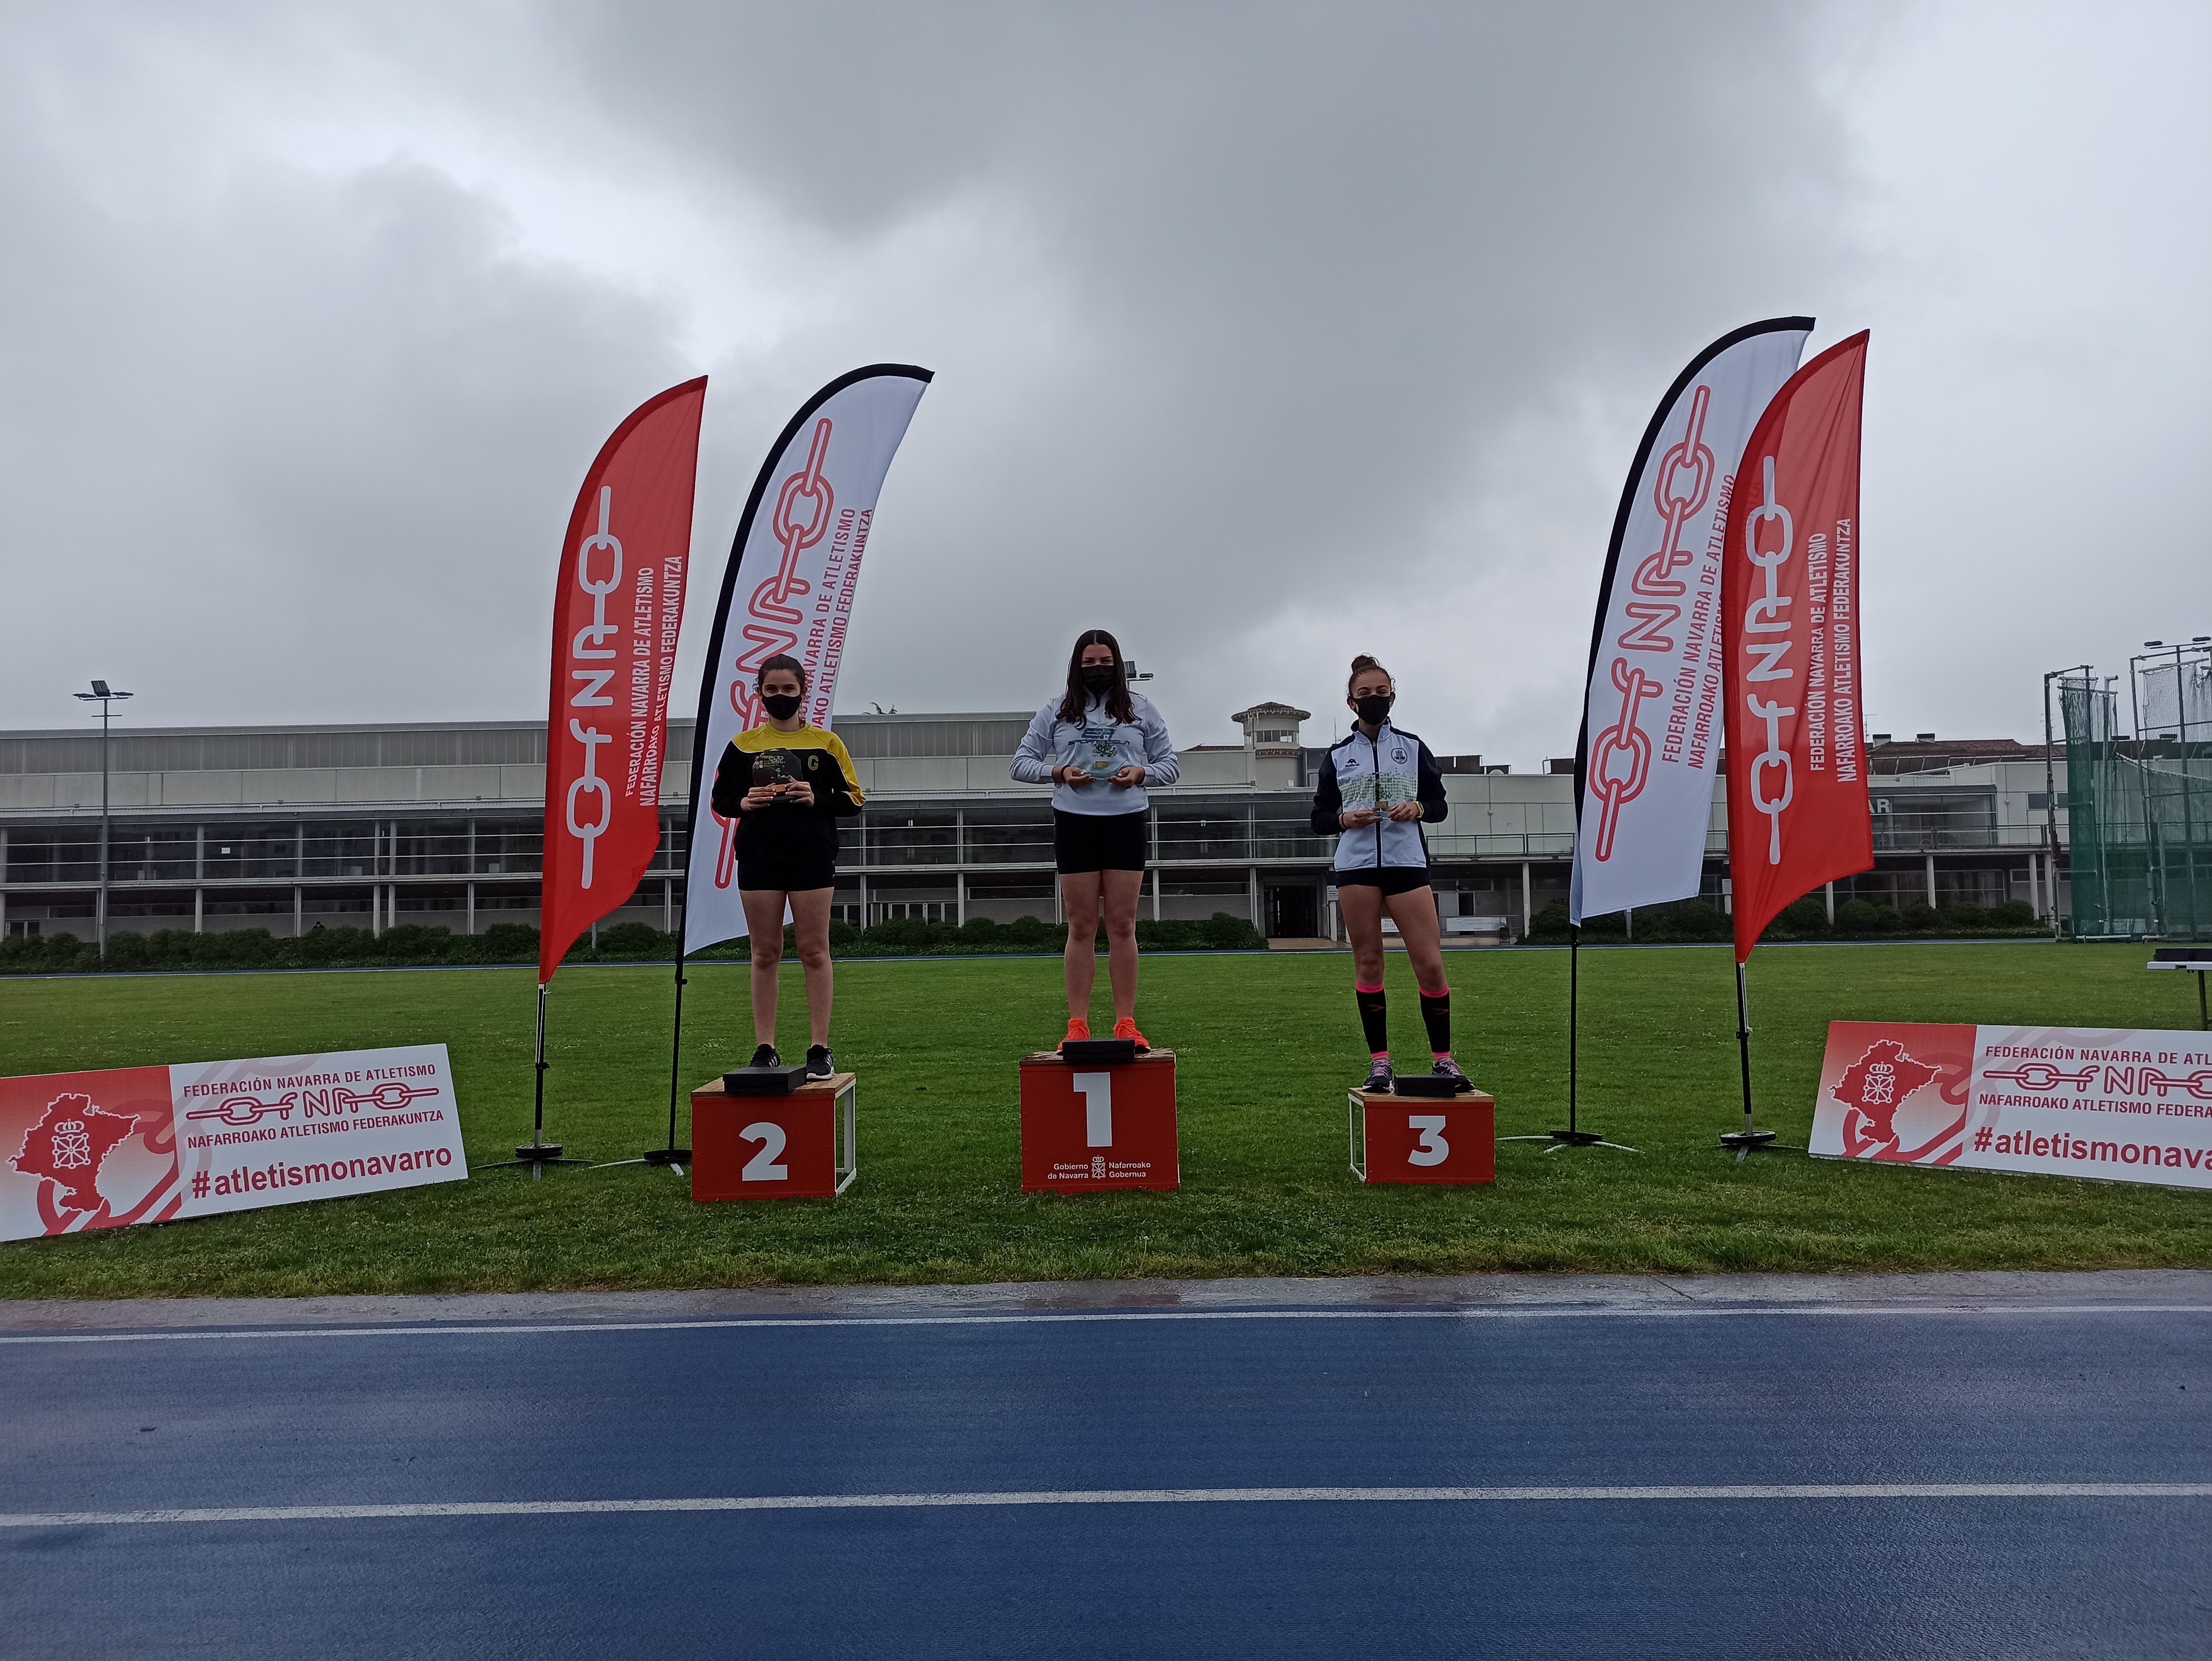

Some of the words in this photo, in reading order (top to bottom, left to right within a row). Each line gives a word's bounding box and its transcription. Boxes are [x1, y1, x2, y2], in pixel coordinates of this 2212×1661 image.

[822, 509, 855, 589] ATLETISMO
[1706, 474, 1735, 562] ATLETISMO
[634, 567, 654, 636] ATLETISMO
[819, 617, 847, 694] ATLETISMO
[836, 509, 873, 613] FEDERAKUNTZA
[1700, 565, 1717, 586] DE
[1808, 533, 1827, 603] ATLETISMO
[1833, 519, 1850, 620] FEDERAKUNTZA
[661, 556, 682, 653] FEDERAKUNTZA
[816, 594, 832, 612] DE
[1682, 591, 1712, 663] NAVARRA
[1810, 607, 1825, 623] DE
[633, 640, 651, 656] DE
[1688, 674, 1719, 769] NAFARROAKO
[1707, 594, 1722, 673] ATLETIS
[1808, 627, 1825, 687] NAVARRA
[1834, 624, 1851, 694] ATLETISMO
[630, 660, 650, 717] NAVARRA
[653, 656, 673, 721] ATLETISMO
[1662, 666, 1697, 763] FEDERACIÓN
[625, 721, 647, 797] FEDERACIÓN
[808, 755, 818, 770] G
[1804, 691, 1826, 771] FEDERACIÓN
[1834, 698, 1857, 782] NAFARROAKO
[640, 725, 660, 807] NAFARROAKO
[183, 1077, 272, 1098] FEDERACIÓN
[277, 1072, 342, 1089] NAVARRA
[344, 1069, 362, 1083] DE
[365, 1063, 436, 1081] ATLETISMO
[1985, 1045, 2075, 1061] FEDERACIÓN
[2080, 1049, 2152, 1063] NAVARRA
[2158, 1052, 2178, 1063] DE
[2184, 1053, 2212, 1065] ATL
[188, 1128, 277, 1148] NAFARROAKO
[280, 1121, 350, 1139] ATLETISMO
[353, 1110, 444, 1131] FEDERAKUNTZA
[1073, 1072, 1112, 1147] 1
[1408, 1115, 1449, 1166] 3
[1979, 1094, 2068, 1109] NAFARROAKO
[2072, 1099, 2152, 1115] ATLETISMO
[2157, 1103, 2212, 1118] FEDERA
[192, 1147, 453, 1199] #atletismonavarro
[739, 1122, 787, 1181] 2
